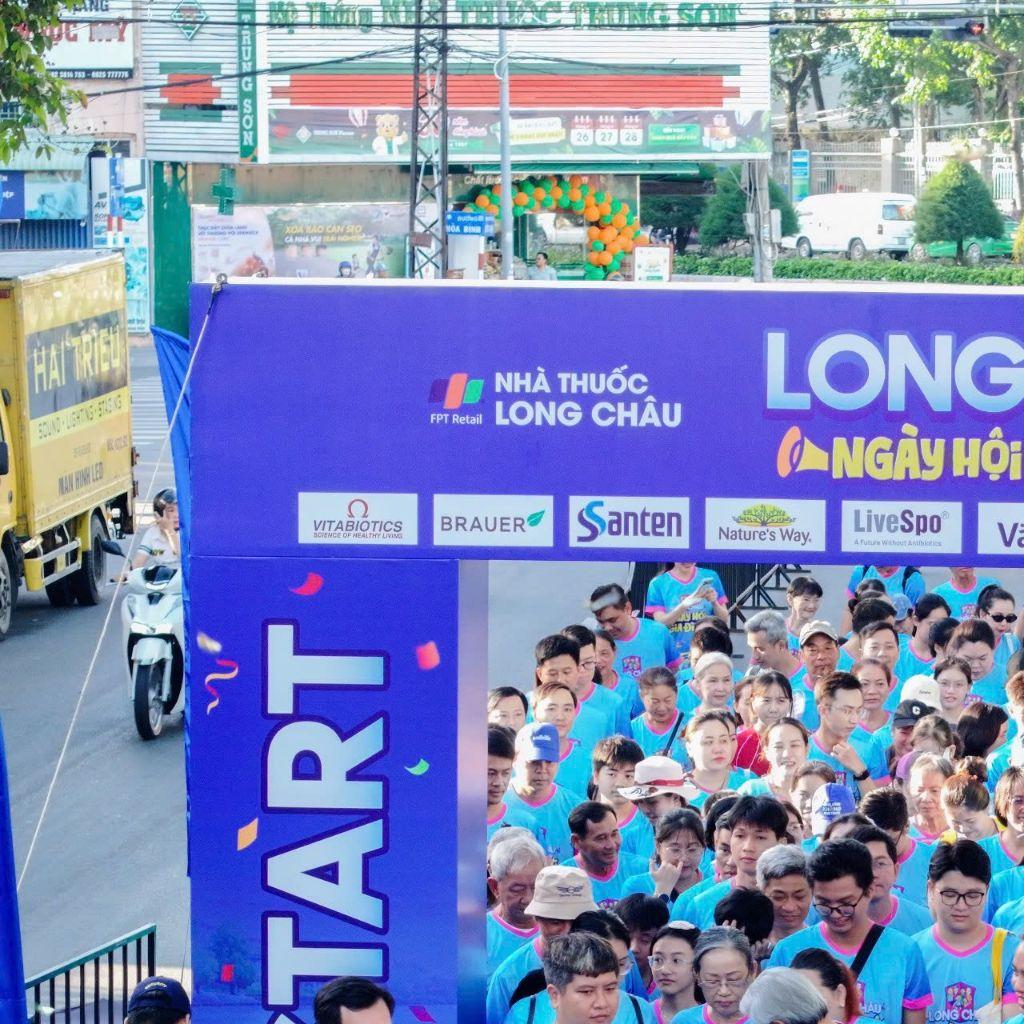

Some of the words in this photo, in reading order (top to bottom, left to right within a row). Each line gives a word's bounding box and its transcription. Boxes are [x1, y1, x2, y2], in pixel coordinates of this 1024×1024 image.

[576, 132, 590, 143] 26
[600, 132, 614, 143] 27
[495, 366, 551, 394] NHÀ
[557, 364, 649, 395] THUỐC
[430, 413, 449, 424] FPT
[451, 413, 482, 425] Retail
[494, 401, 583, 427] LONG
[591, 395, 682, 428] CHÂU
[313, 519, 403, 533] VITABIOTICS
[440, 515, 526, 533] BRAUER
[576, 500, 683, 543] Santen
[718, 526, 777, 542] Nature's
